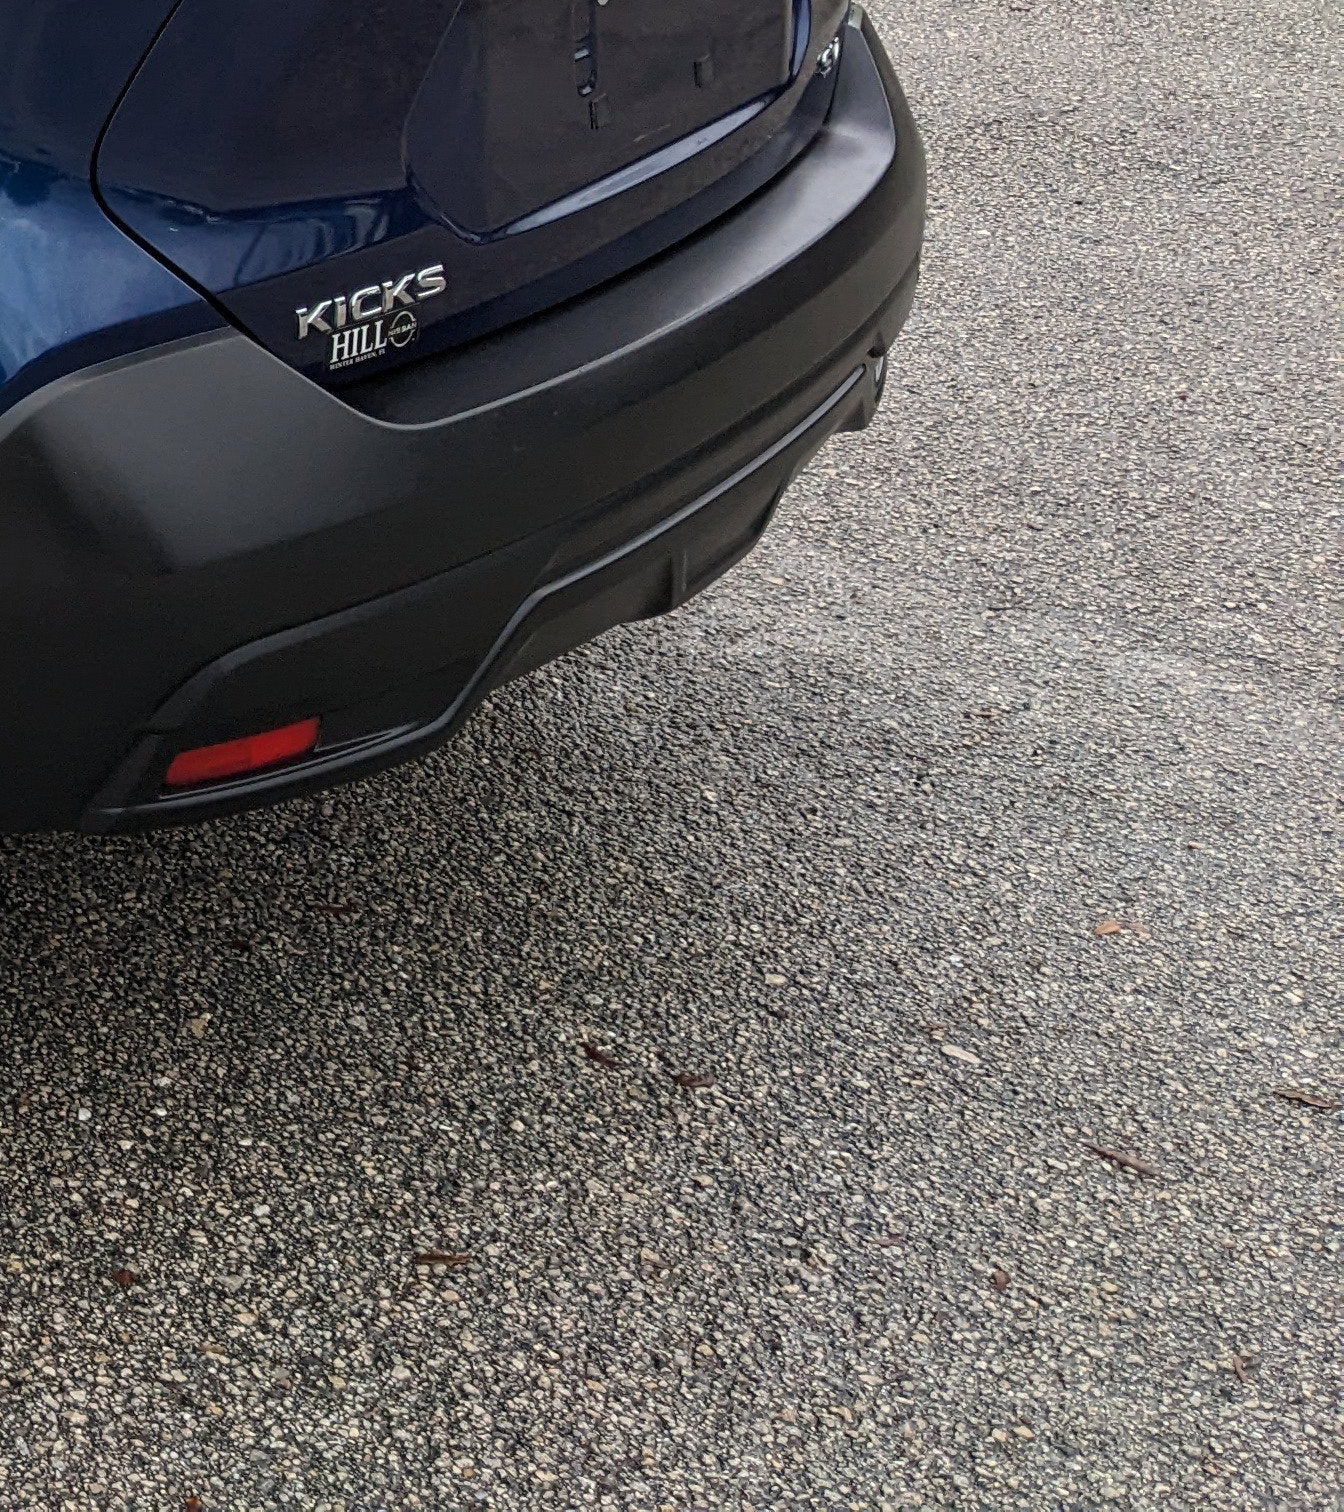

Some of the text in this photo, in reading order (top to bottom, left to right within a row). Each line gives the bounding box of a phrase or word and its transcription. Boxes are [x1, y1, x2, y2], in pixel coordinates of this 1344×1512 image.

[296, 264, 447, 339] KICKS
[330, 320, 388, 364] HILL
[388, 321, 418, 336] NISSAN
[329, 358, 354, 370] WINTER
